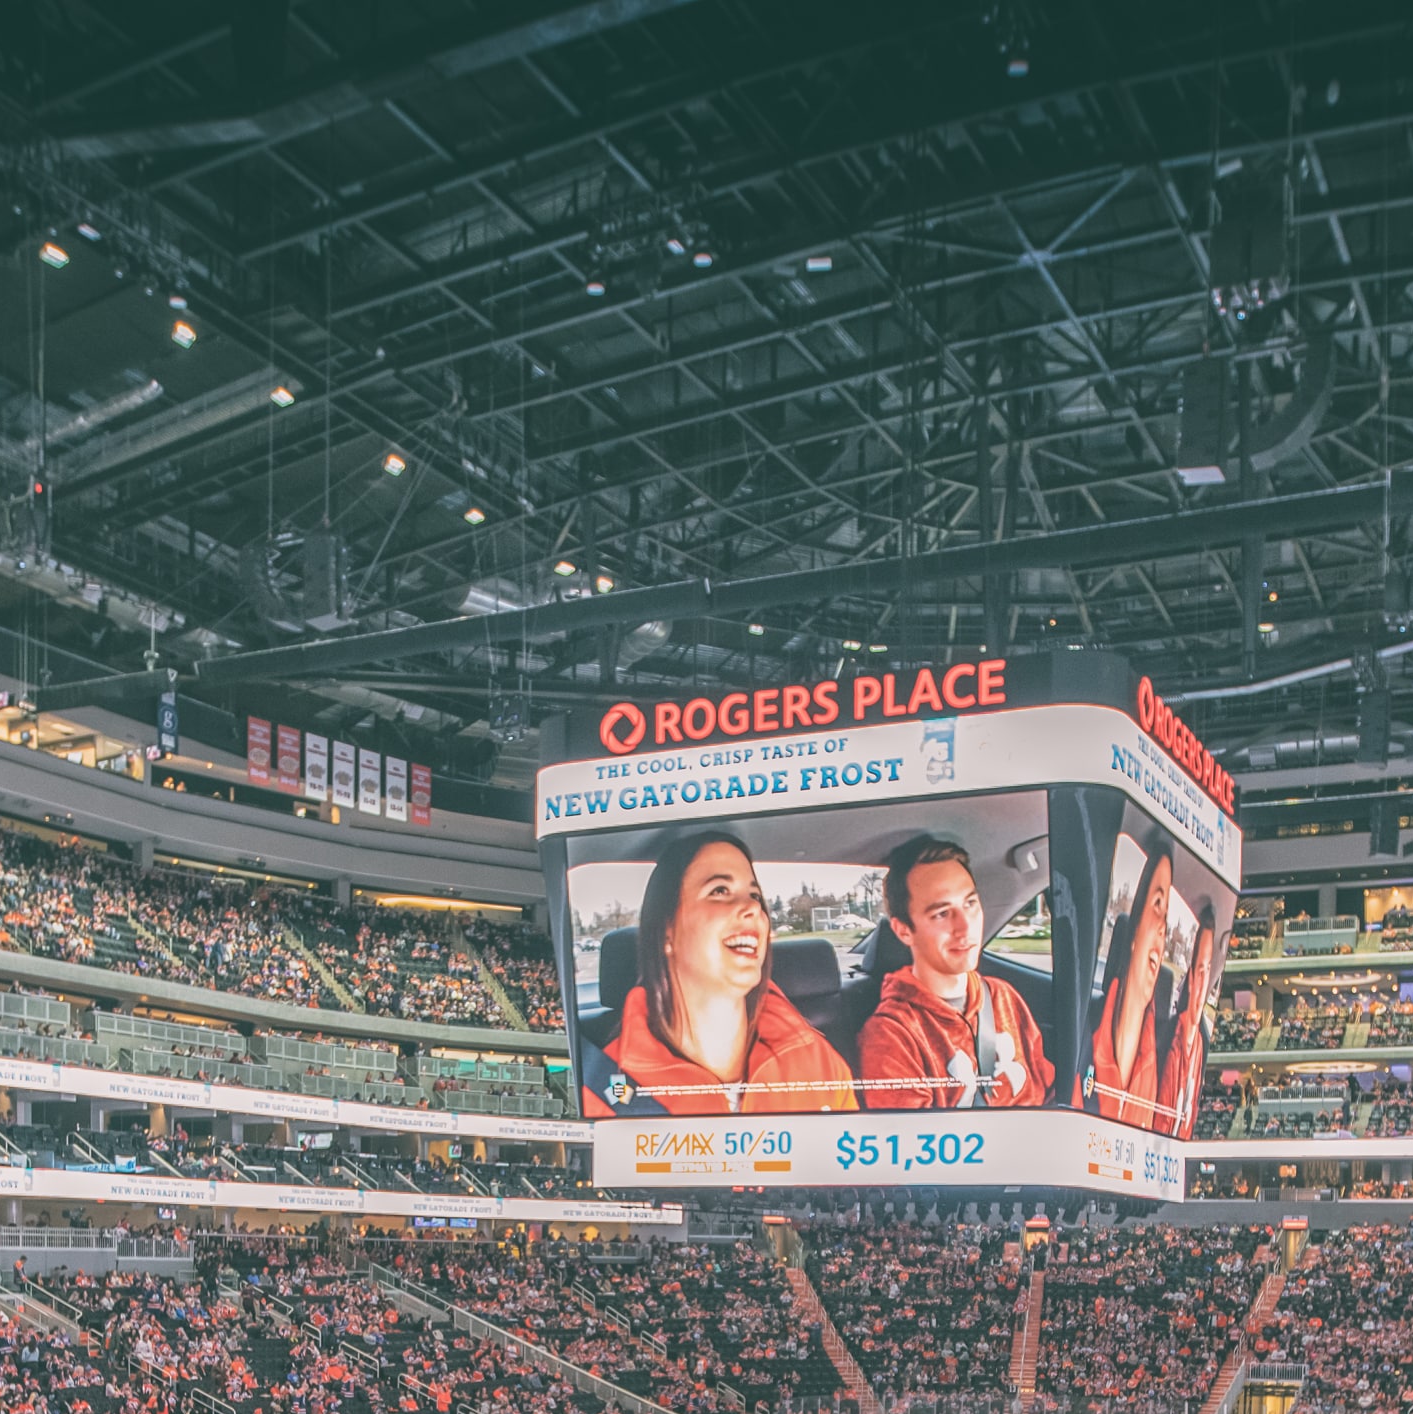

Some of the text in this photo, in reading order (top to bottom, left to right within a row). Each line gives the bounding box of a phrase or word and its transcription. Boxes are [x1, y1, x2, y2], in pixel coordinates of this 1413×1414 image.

[655, 659, 1006, 745] ROGERS PLACE
[596, 738, 849, 780] THE COOL, CRISP TASTE OF
[1111, 743, 1143, 786] NEW
[1144, 769, 1189, 829] GATORADE
[1154, 696, 1234, 816] ROGERS PLACE
[545, 758, 904, 821] NEW GATORADE FROST
[636, 1131, 792, 1157] RE/MAX 50/50
[836, 1131, 985, 1171] $51,302
